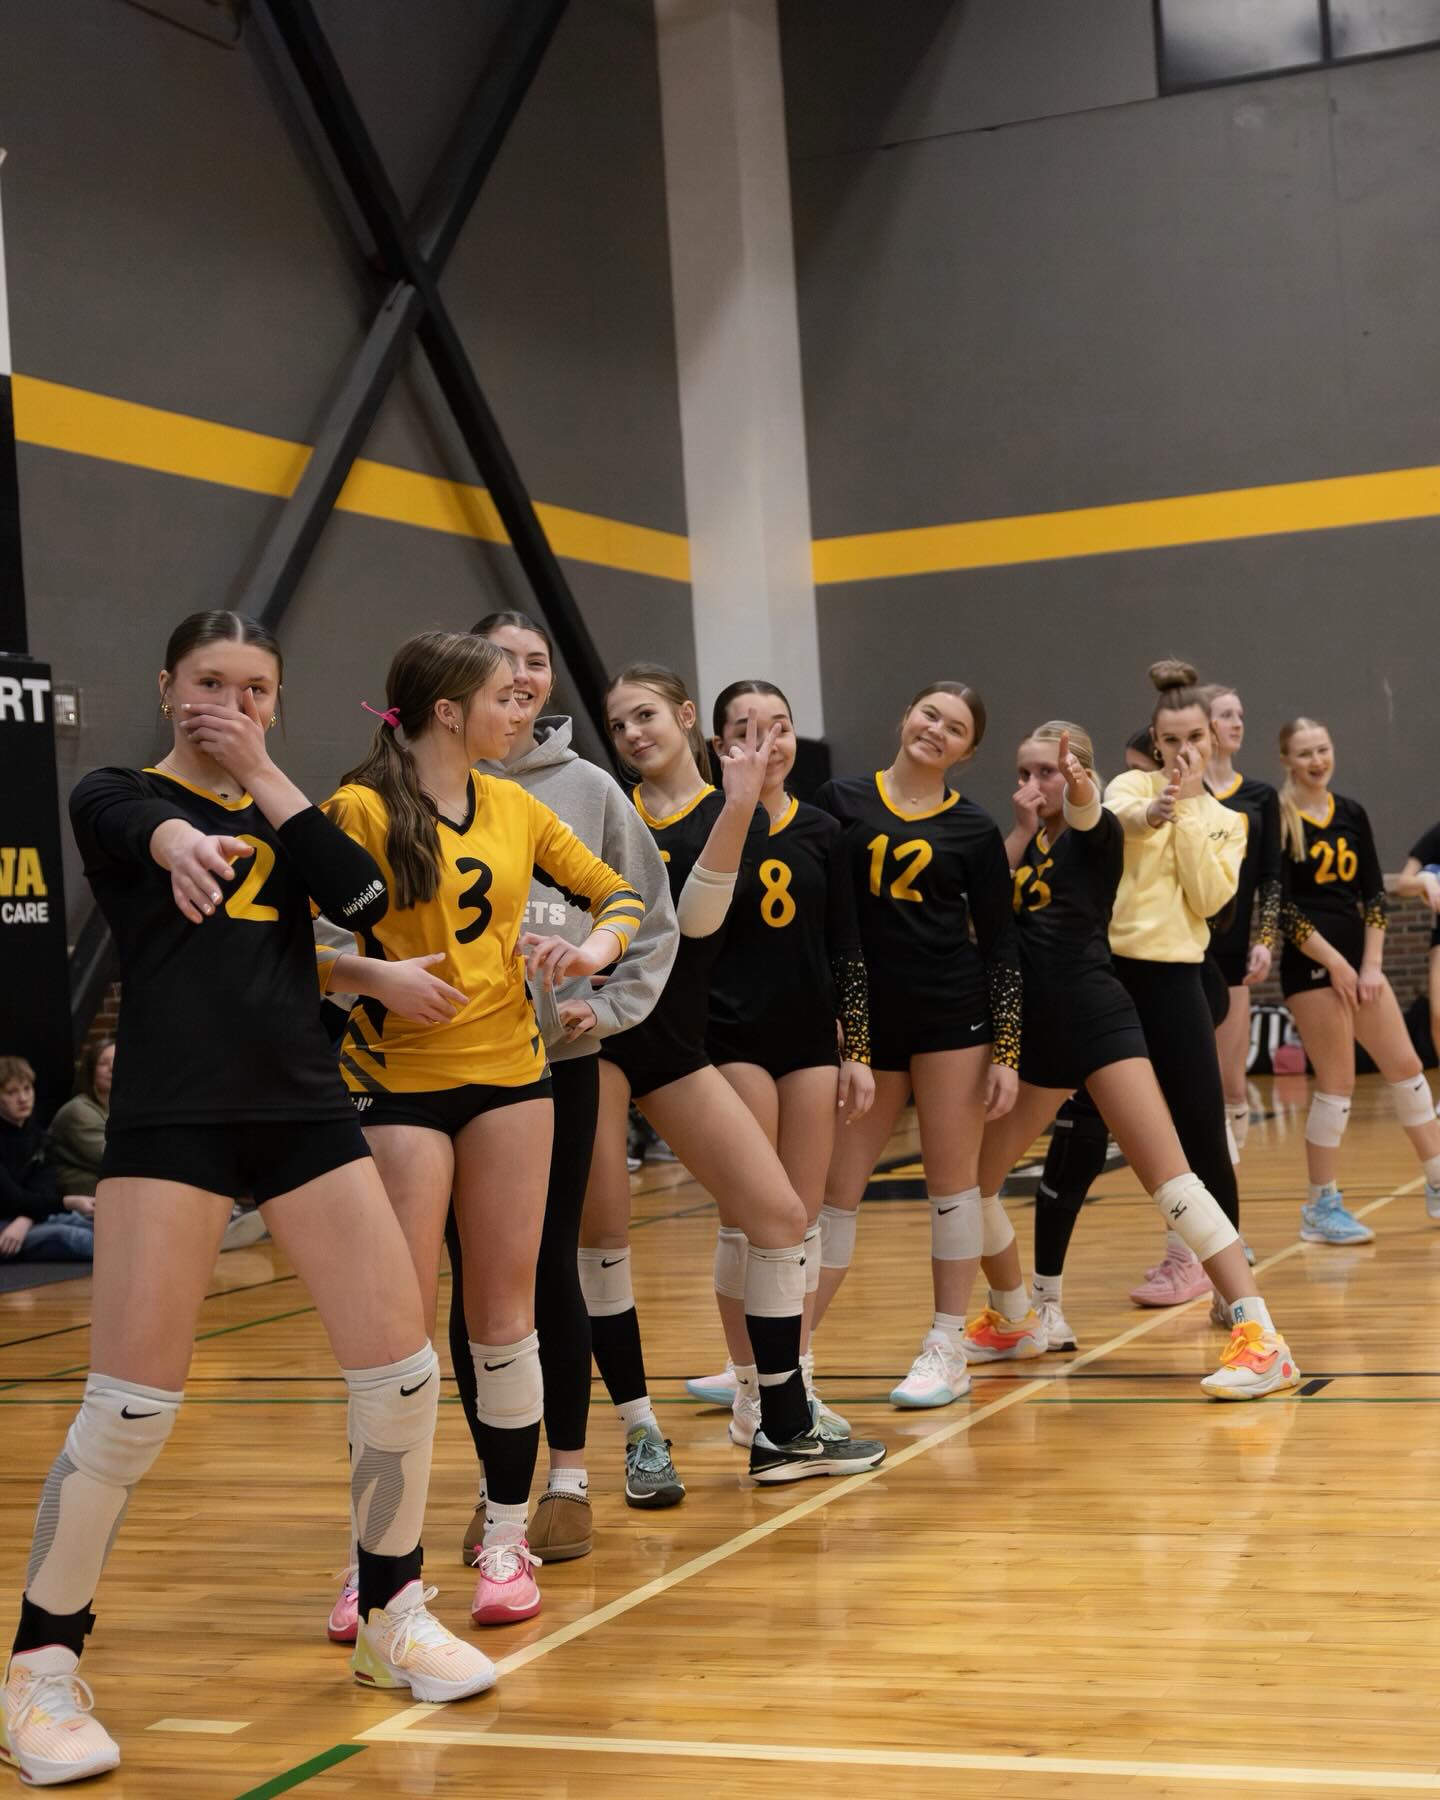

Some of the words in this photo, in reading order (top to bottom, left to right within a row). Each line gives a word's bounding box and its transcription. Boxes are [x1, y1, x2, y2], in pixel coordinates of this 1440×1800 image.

[225, 834, 279, 922] 2
[759, 859, 796, 928] 8
[867, 833, 933, 903] 12
[1310, 837, 1358, 884] 26
[1, 902, 49, 924] CARE
[455, 857, 493, 944] 3
